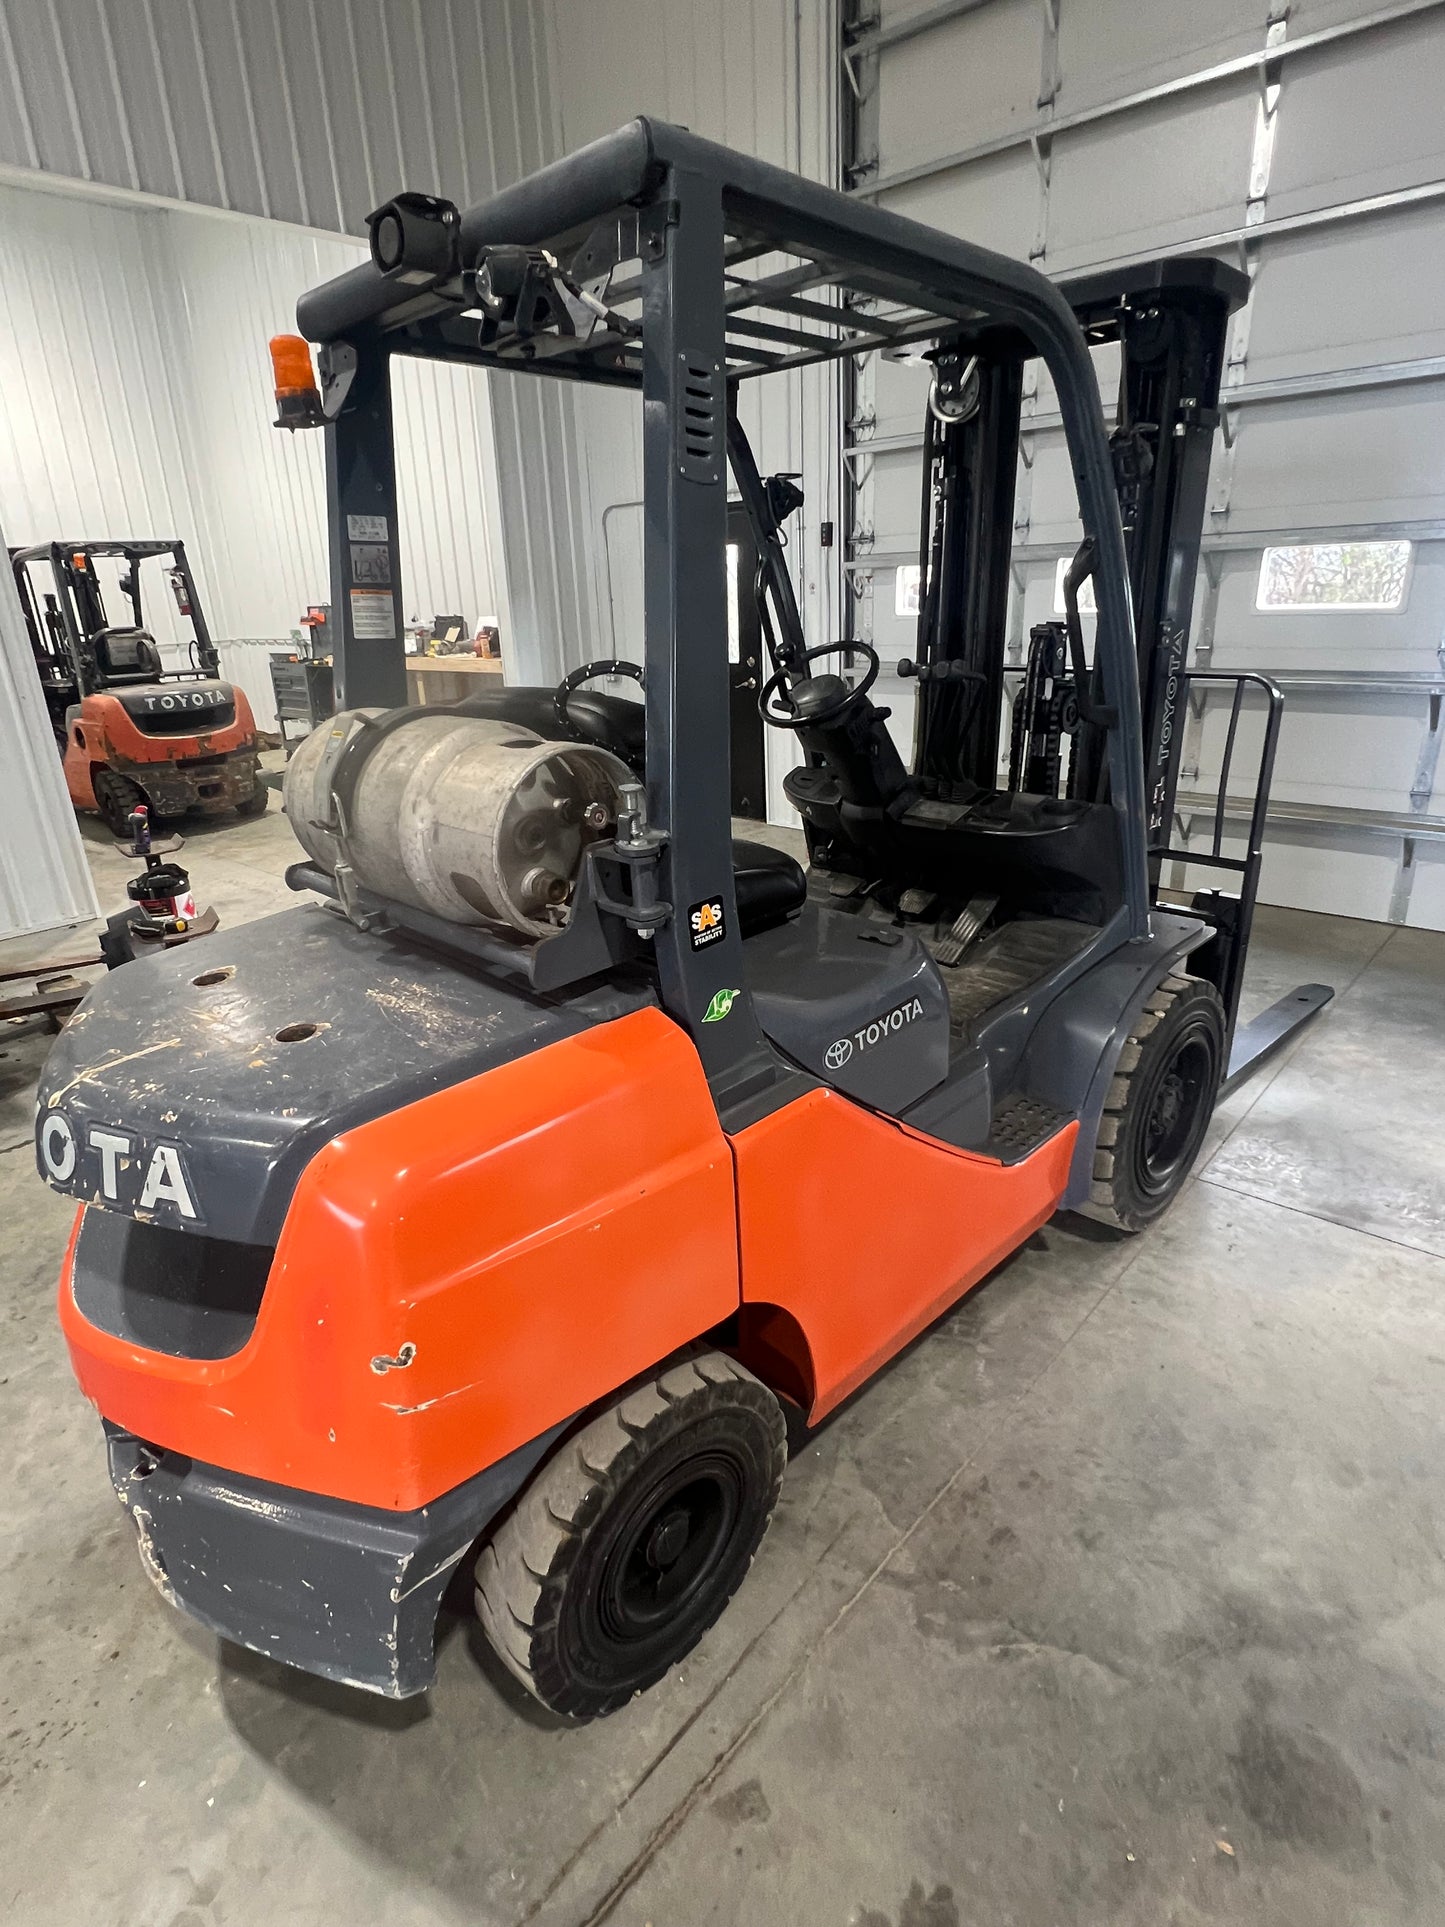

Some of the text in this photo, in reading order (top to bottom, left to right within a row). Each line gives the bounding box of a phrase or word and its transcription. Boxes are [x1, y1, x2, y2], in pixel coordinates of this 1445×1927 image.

[144, 690, 226, 711] TOYOTA
[1157, 629, 1185, 766] TOYOTA
[691, 903, 722, 932] SAS
[694, 929, 723, 946] STABILITY
[854, 998, 924, 1051] TOYOTA
